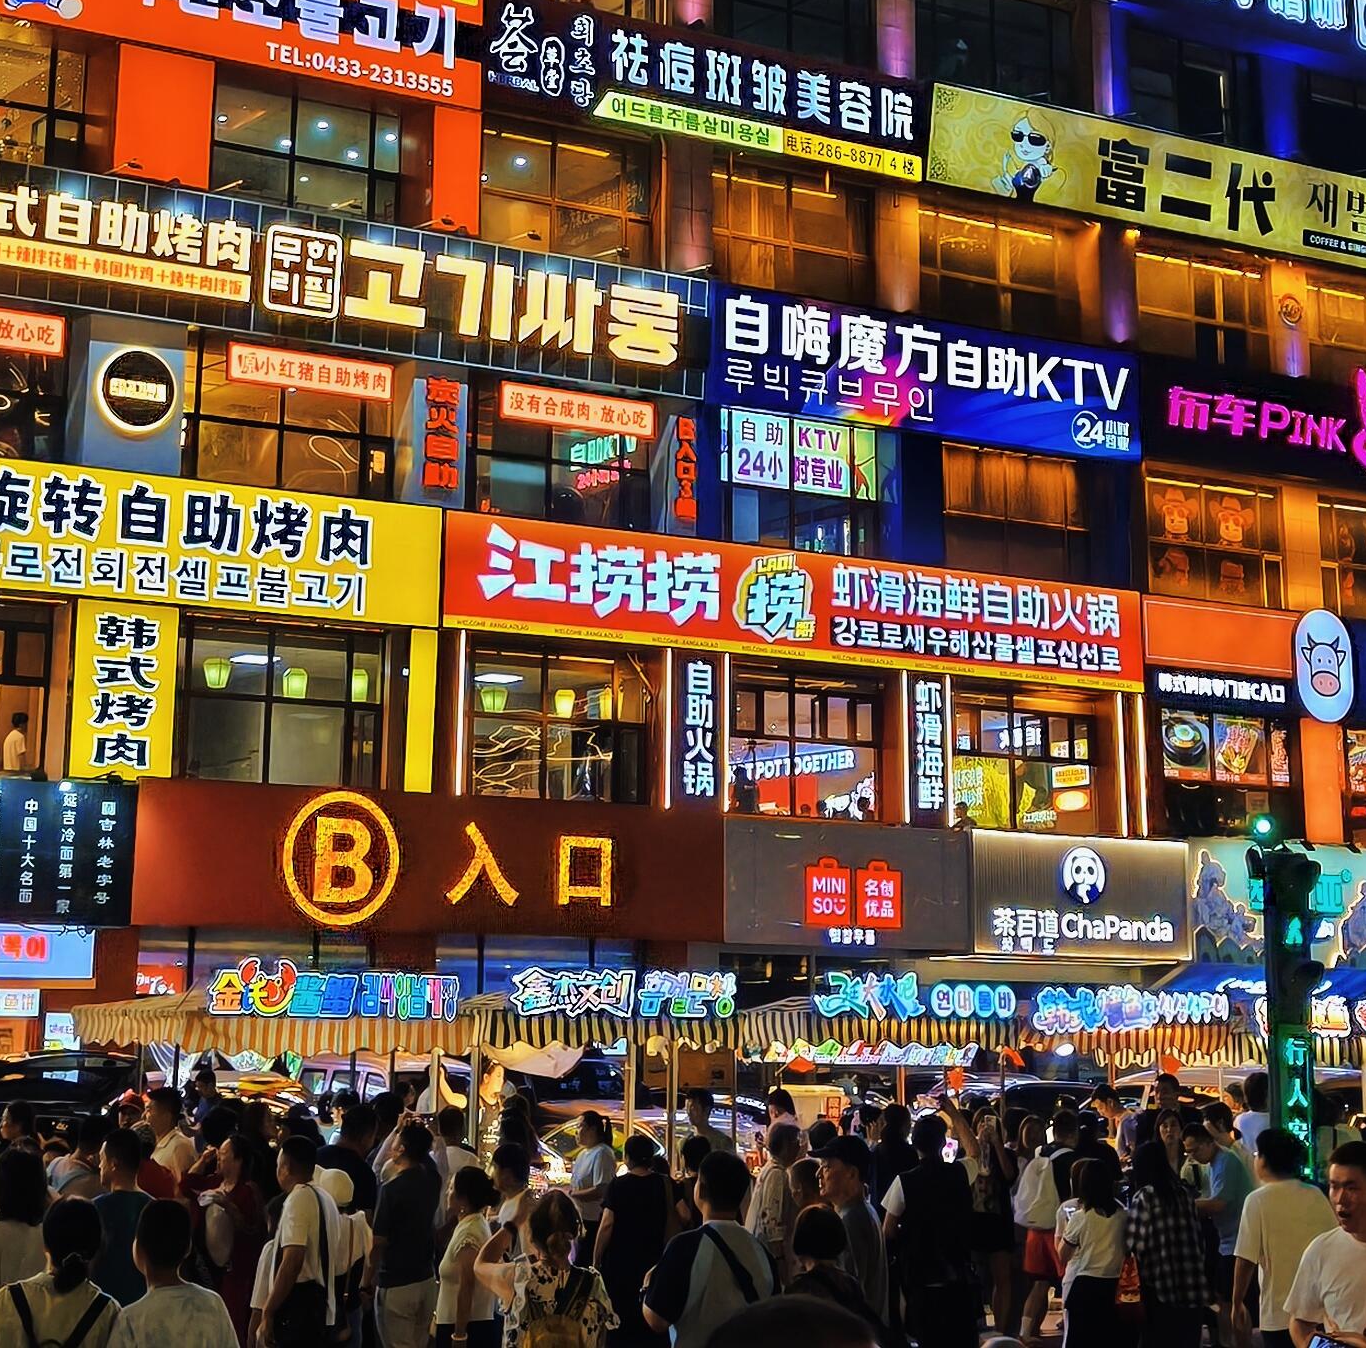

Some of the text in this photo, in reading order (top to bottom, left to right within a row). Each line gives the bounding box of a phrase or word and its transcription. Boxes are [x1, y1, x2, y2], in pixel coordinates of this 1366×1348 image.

[610, 28, 915, 142] 祛痘斑皱美容院
[1096, 138, 1276, 236] 富二代
[344, 242, 680, 366] 고기싸롱
[725, 295, 1130, 411] 自嗨魔方自助KTV
[724, 358, 935, 424] 루빅큐브무인
[741, 417, 842, 453] 自助 KTV
[477, 522, 722, 627] 江捞捞
[831, 564, 1120, 639] 虾滑海鲜自助火锅
[91, 613, 161, 768] 韩式烤肉
[682, 658, 716, 798] 自助火锅
[913, 679, 945, 811] 虾滑海鲜
[18, 798, 39, 904] 中国十大名面
[55, 792, 78, 914] 延吉冷面第一家
[446, 822, 615, 907] 入口
[812, 876, 846, 894] MINI
[864, 878, 894, 898] 名创
[864, 898, 895, 919] 优品
[993, 908, 1174, 943] 茶百道 ChaPanda
